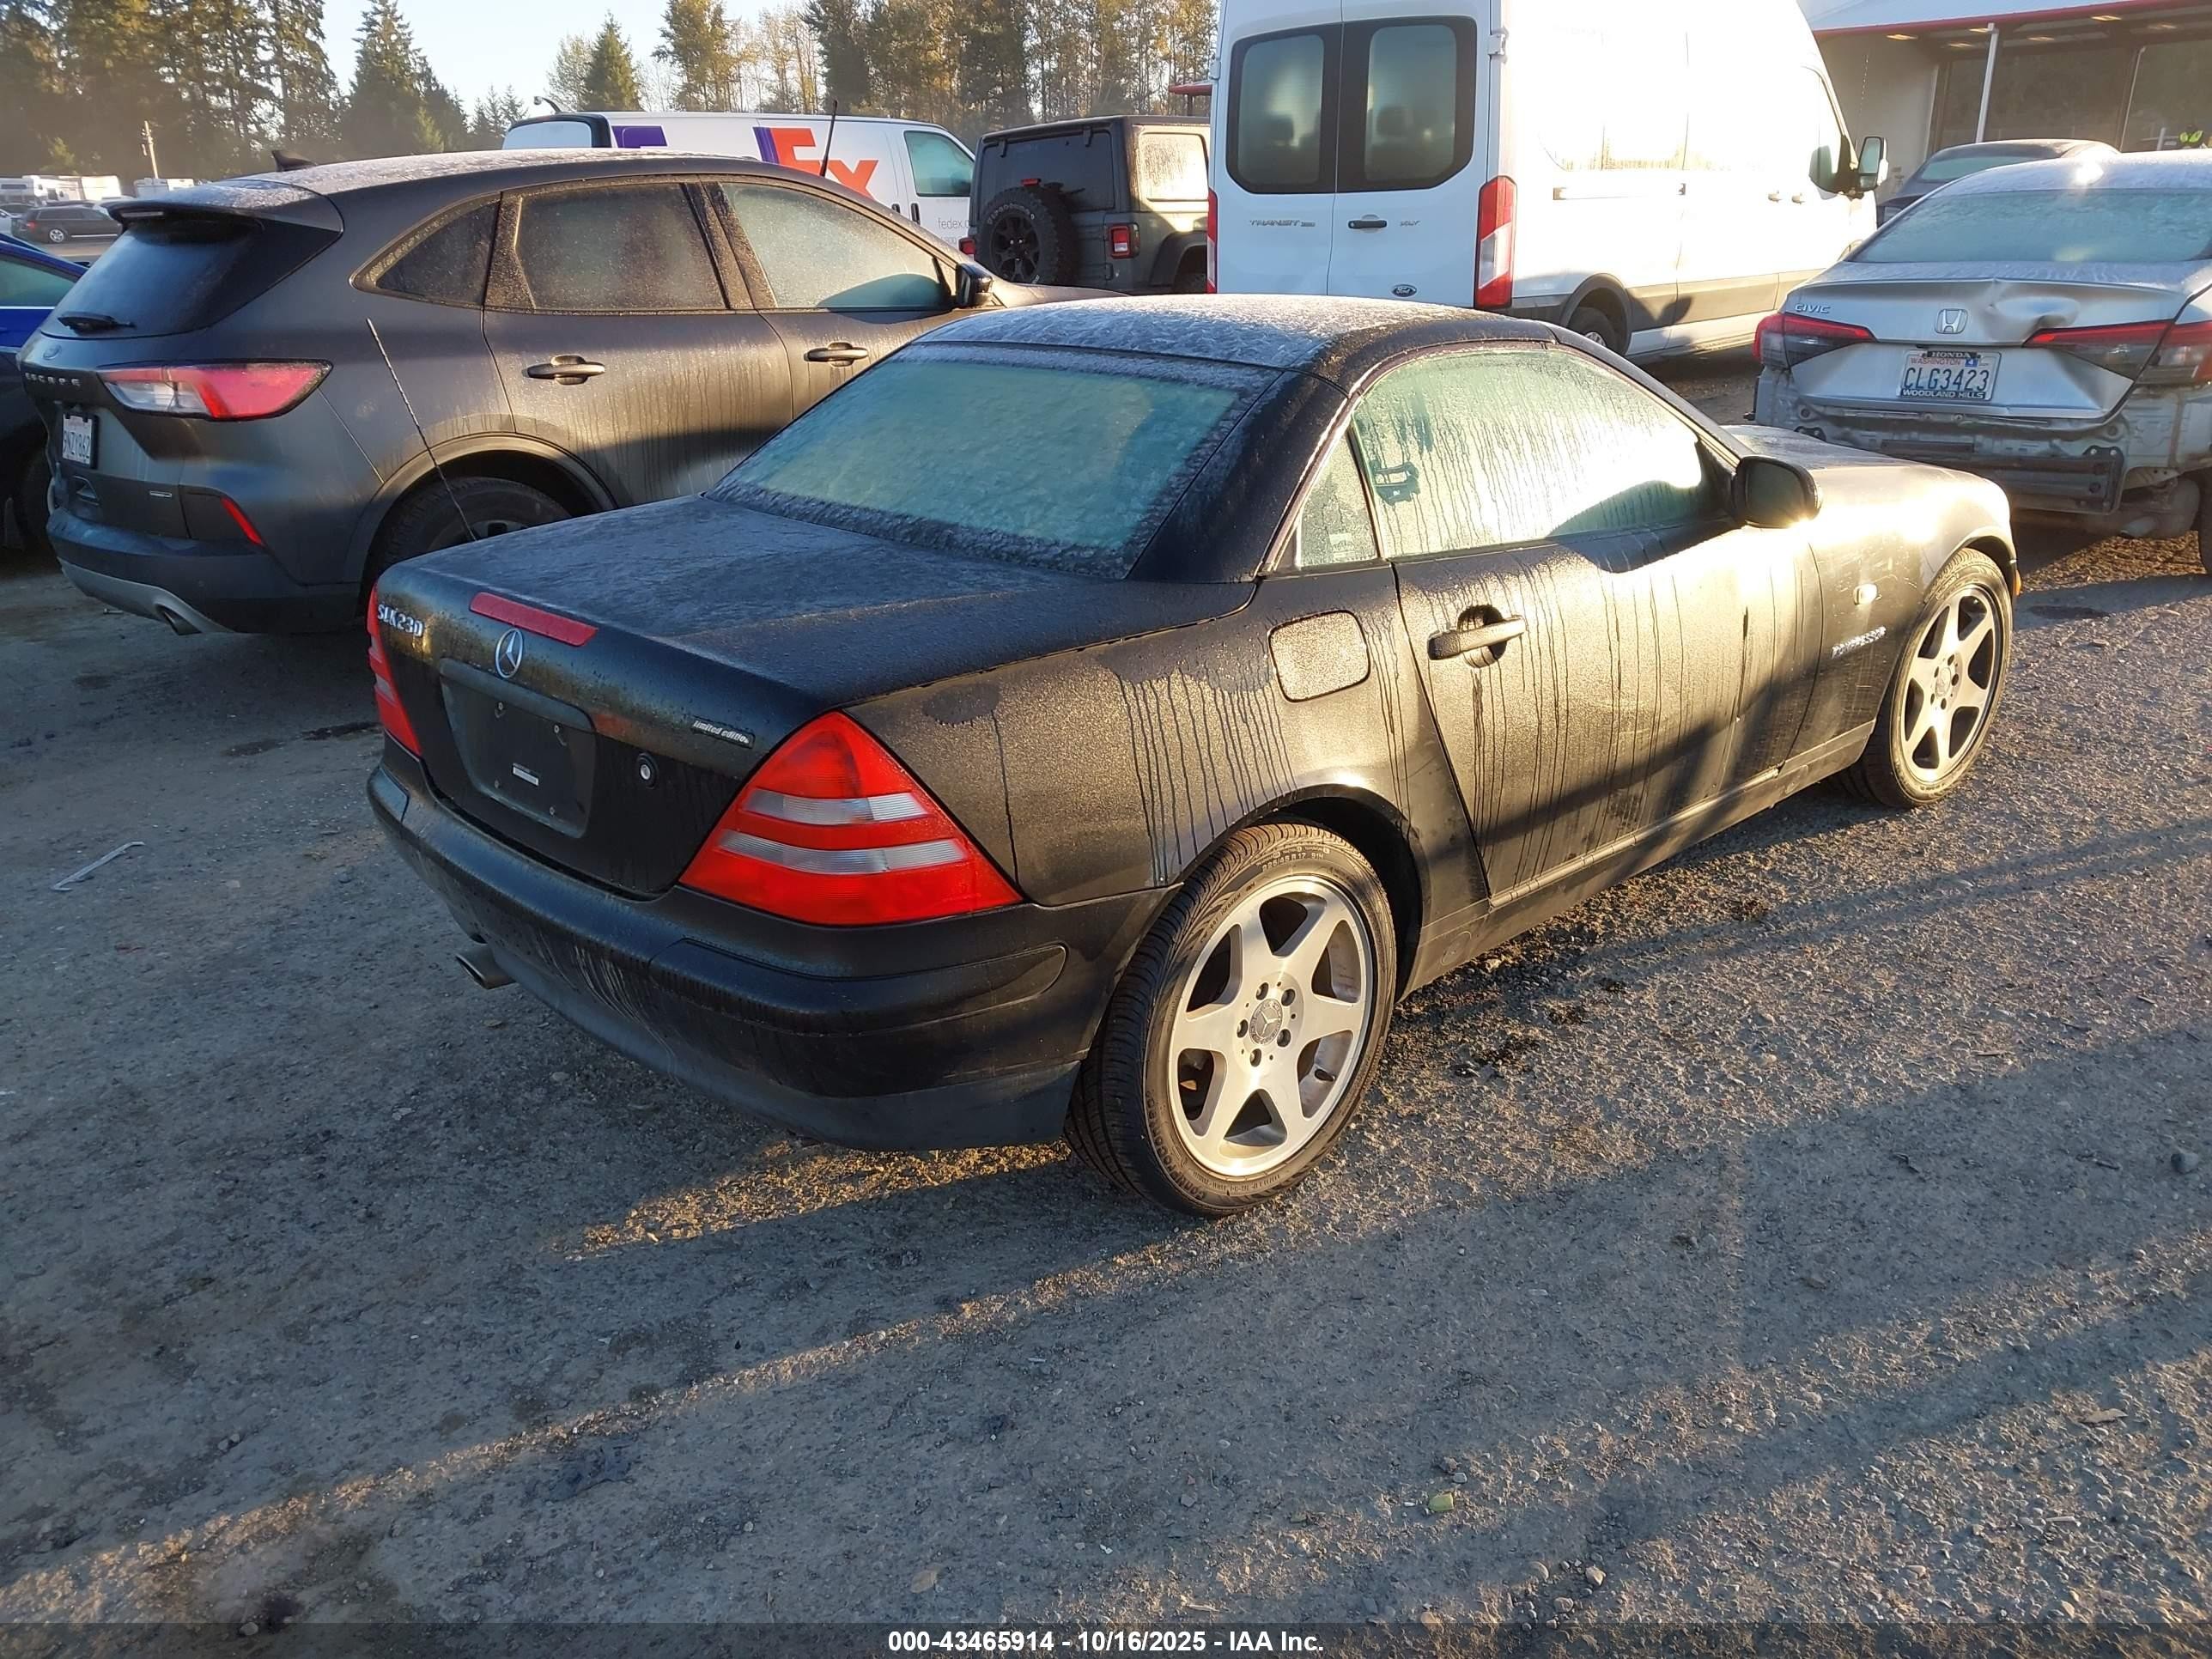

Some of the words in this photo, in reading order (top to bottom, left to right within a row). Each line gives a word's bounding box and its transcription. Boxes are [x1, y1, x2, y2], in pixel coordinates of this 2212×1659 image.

[1795, 303, 1832, 314] CIVIC
[1910, 357, 1961, 366] WASHINGTON
[25, 372, 81, 386] ESCAPE
[1903, 367, 1990, 392] CLG3423
[1902, 388, 1957, 398] WOODLAND
[1958, 391, 1985, 399] HILLS
[377, 603, 424, 637] SLK230
[692, 720, 723, 735] limited
